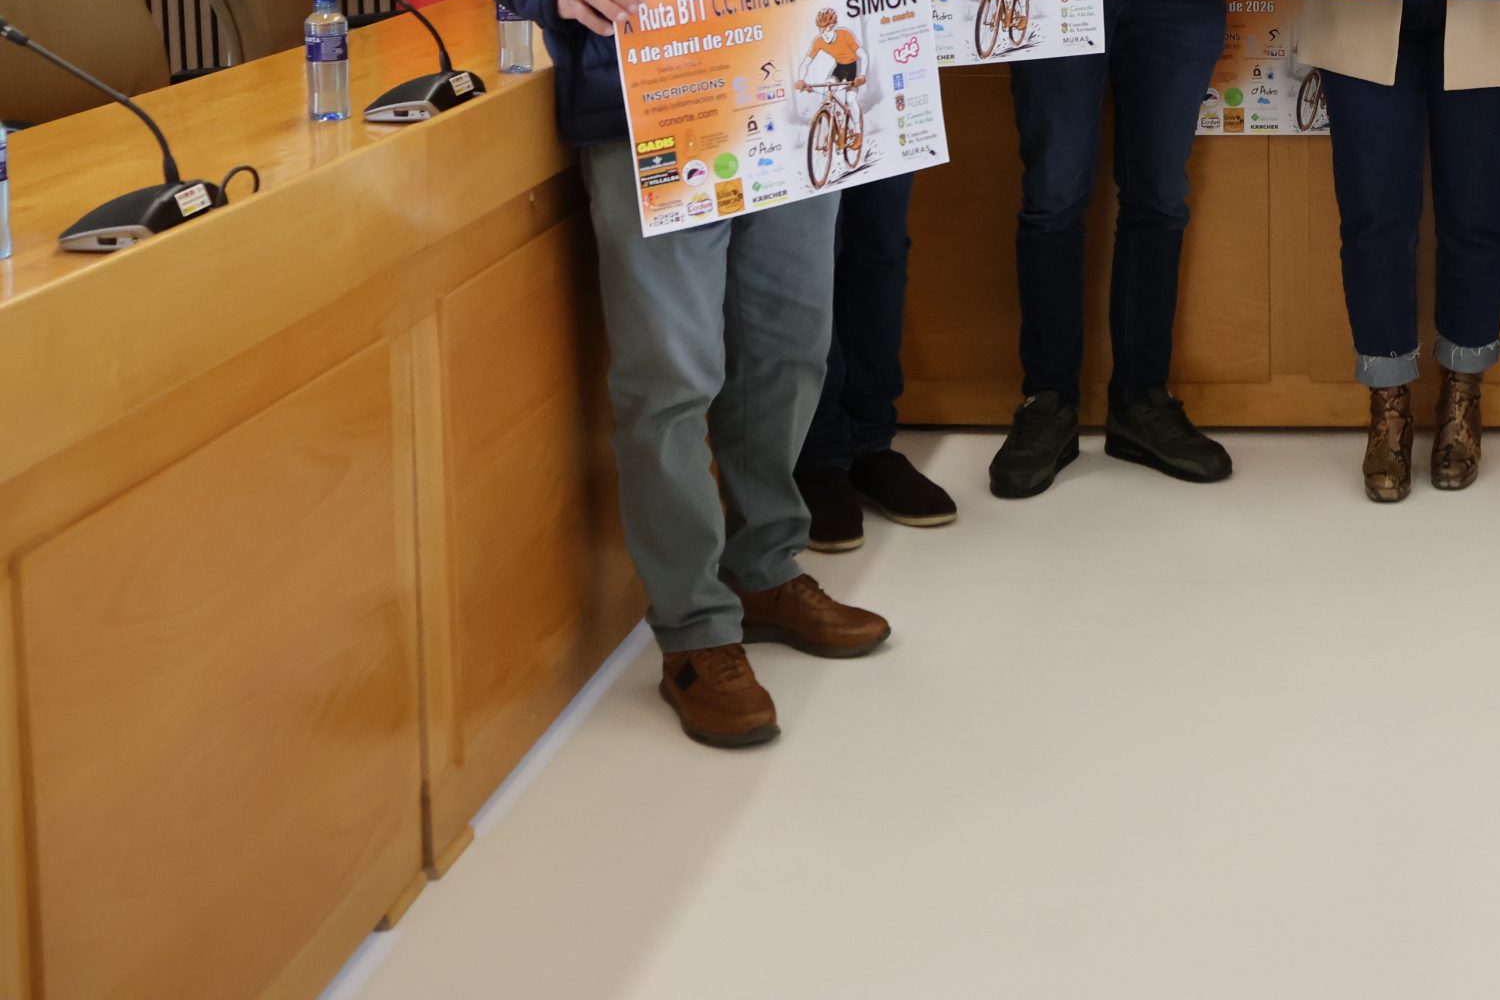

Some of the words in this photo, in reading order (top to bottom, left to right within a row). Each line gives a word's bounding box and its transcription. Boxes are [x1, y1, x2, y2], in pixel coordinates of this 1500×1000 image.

[626, 48, 638, 65] 4
[640, 43, 660, 63] de
[662, 36, 699, 58] abril
[702, 32, 722, 50] de
[724, 24, 764, 46] 2026
[637, 136, 674, 154] GADIS
